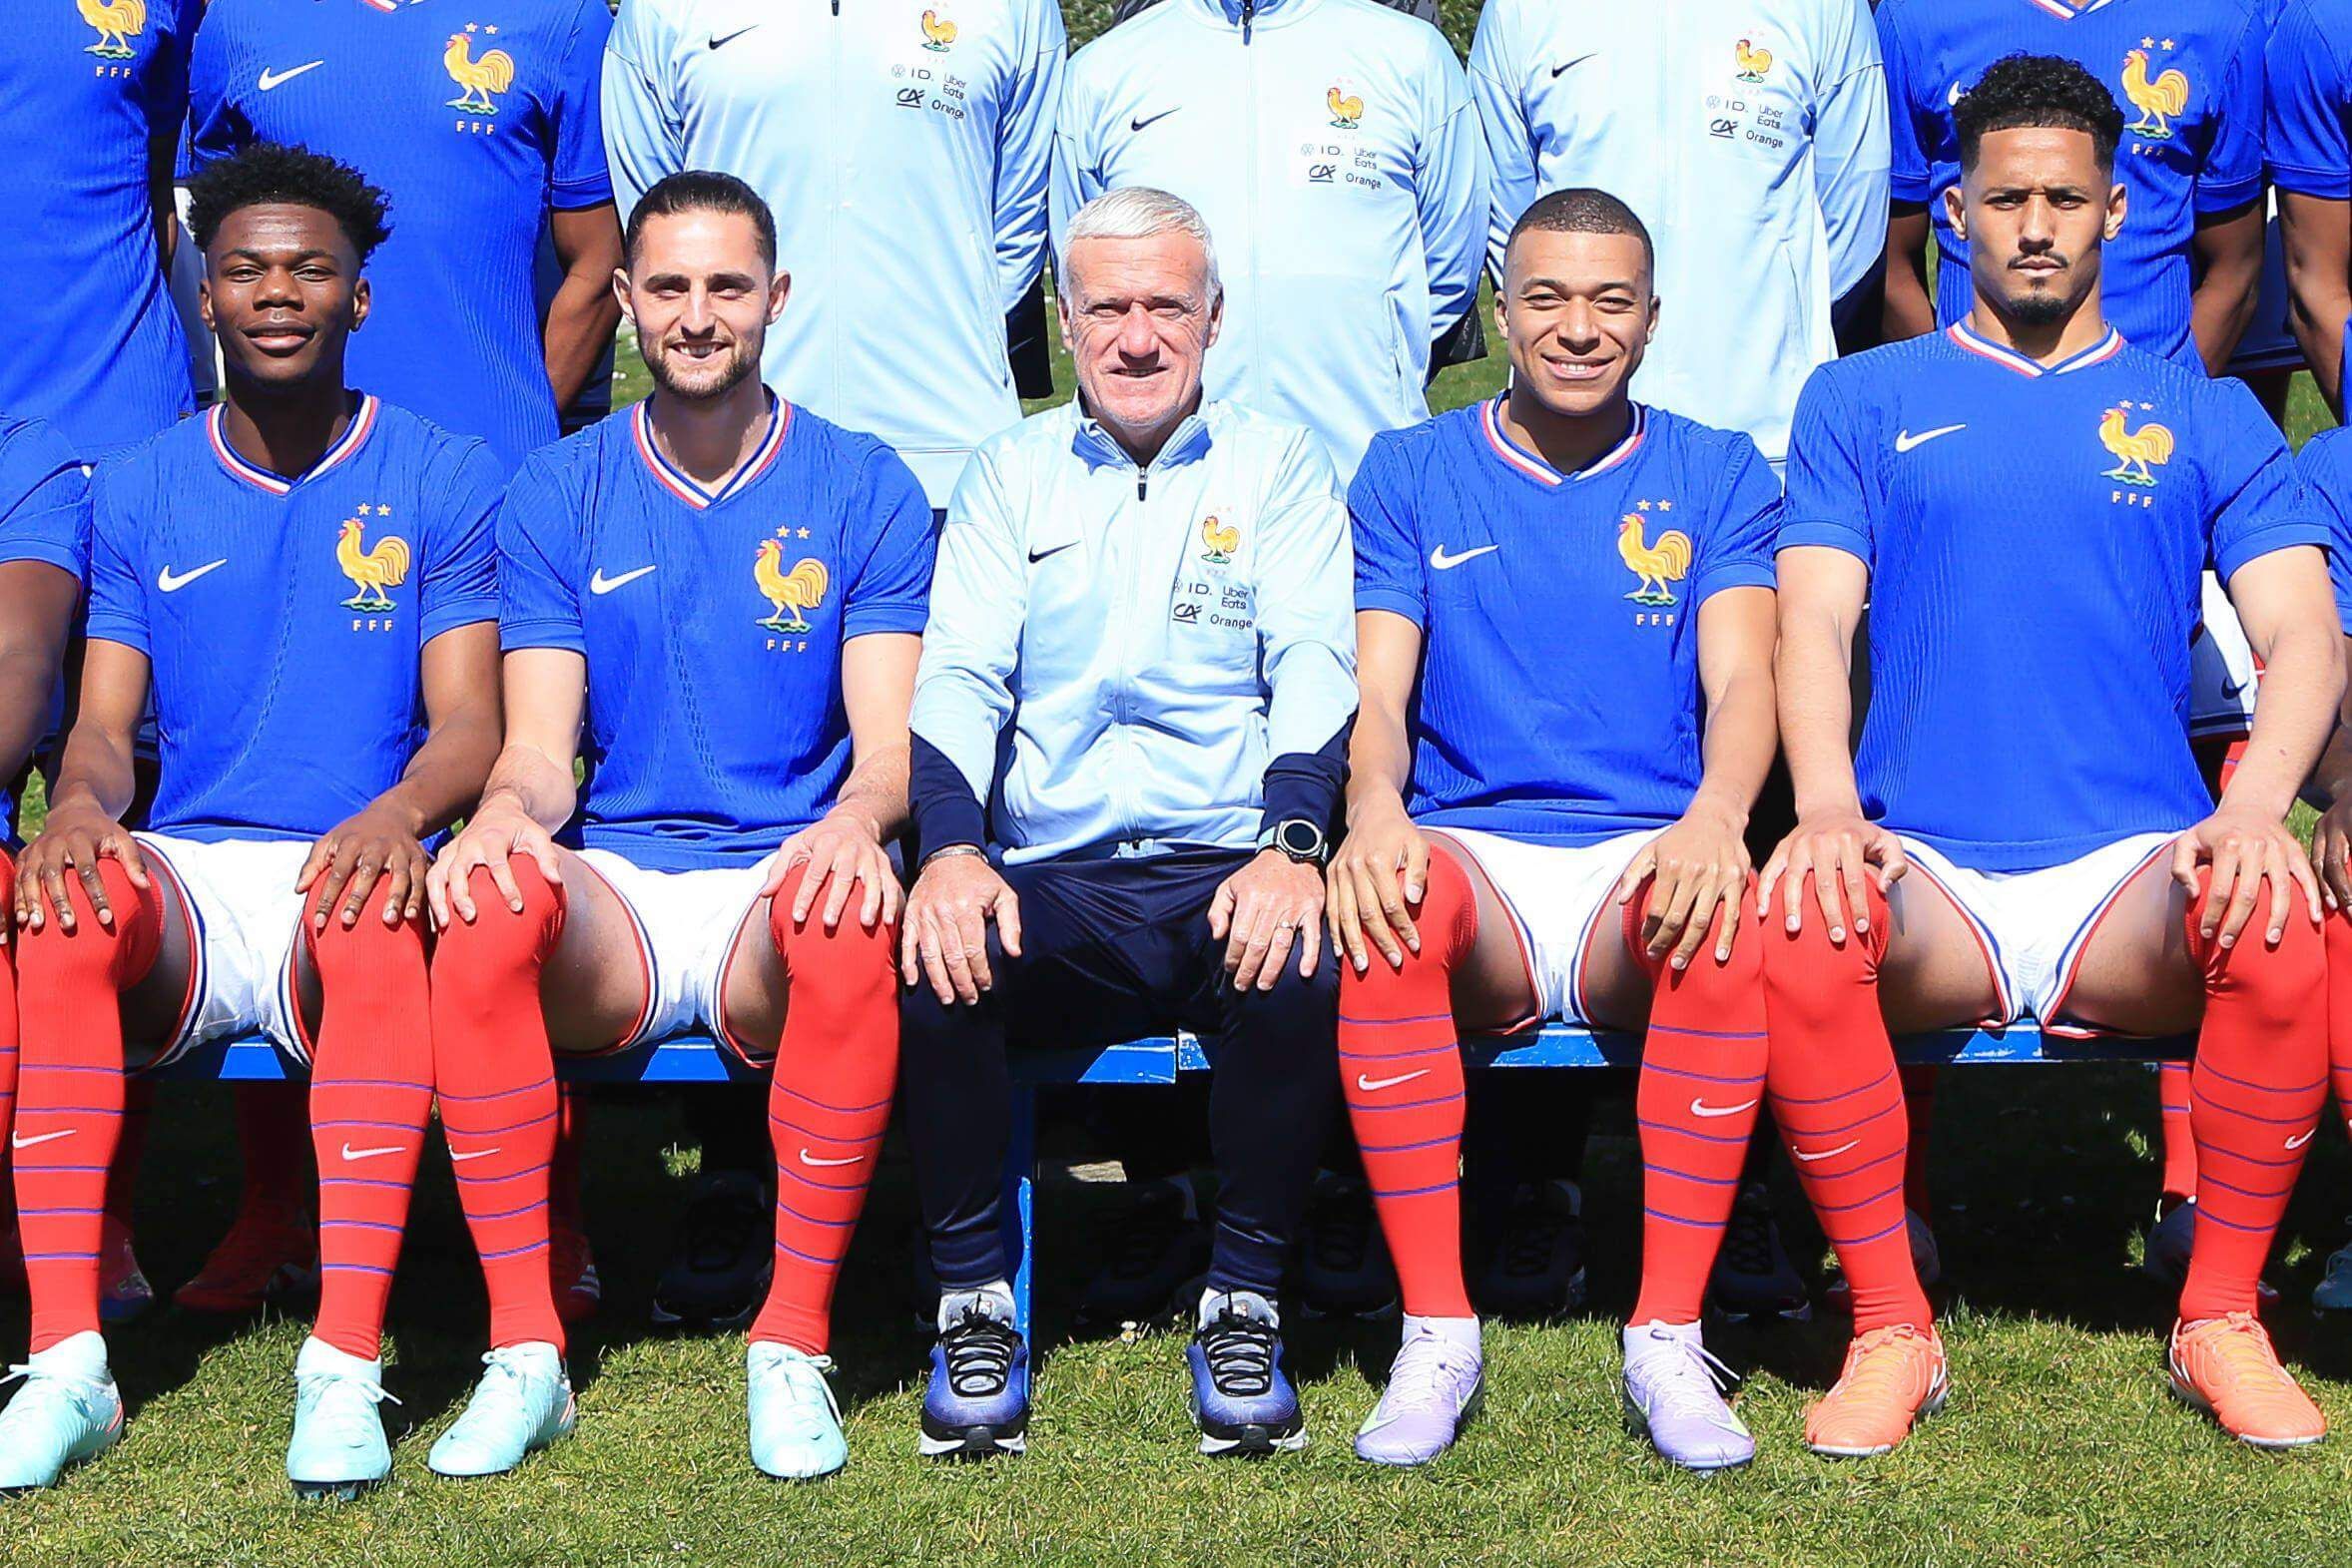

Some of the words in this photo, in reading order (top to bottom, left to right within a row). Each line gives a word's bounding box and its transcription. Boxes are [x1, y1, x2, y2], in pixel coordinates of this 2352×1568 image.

[943, 84, 964, 100] Eats
[931, 99, 964, 119] Orange
[1759, 104, 1783, 118] Uber
[456, 120, 494, 135] FFF
[1757, 115, 1781, 129] Eats
[1746, 130, 1783, 149] Orange
[1355, 158, 1377, 170] Eats
[1346, 173, 1382, 190] Orange
[2112, 490, 2152, 508] FFF
[1188, 583, 1212, 596] ID.
[1223, 586, 1248, 599] Uber
[1221, 597, 1247, 610] Eats
[353, 619, 392, 632] FFF
[1210, 614, 1253, 630] Orange
[1636, 613, 1674, 627] FFF
[767, 639, 807, 653] FFF
